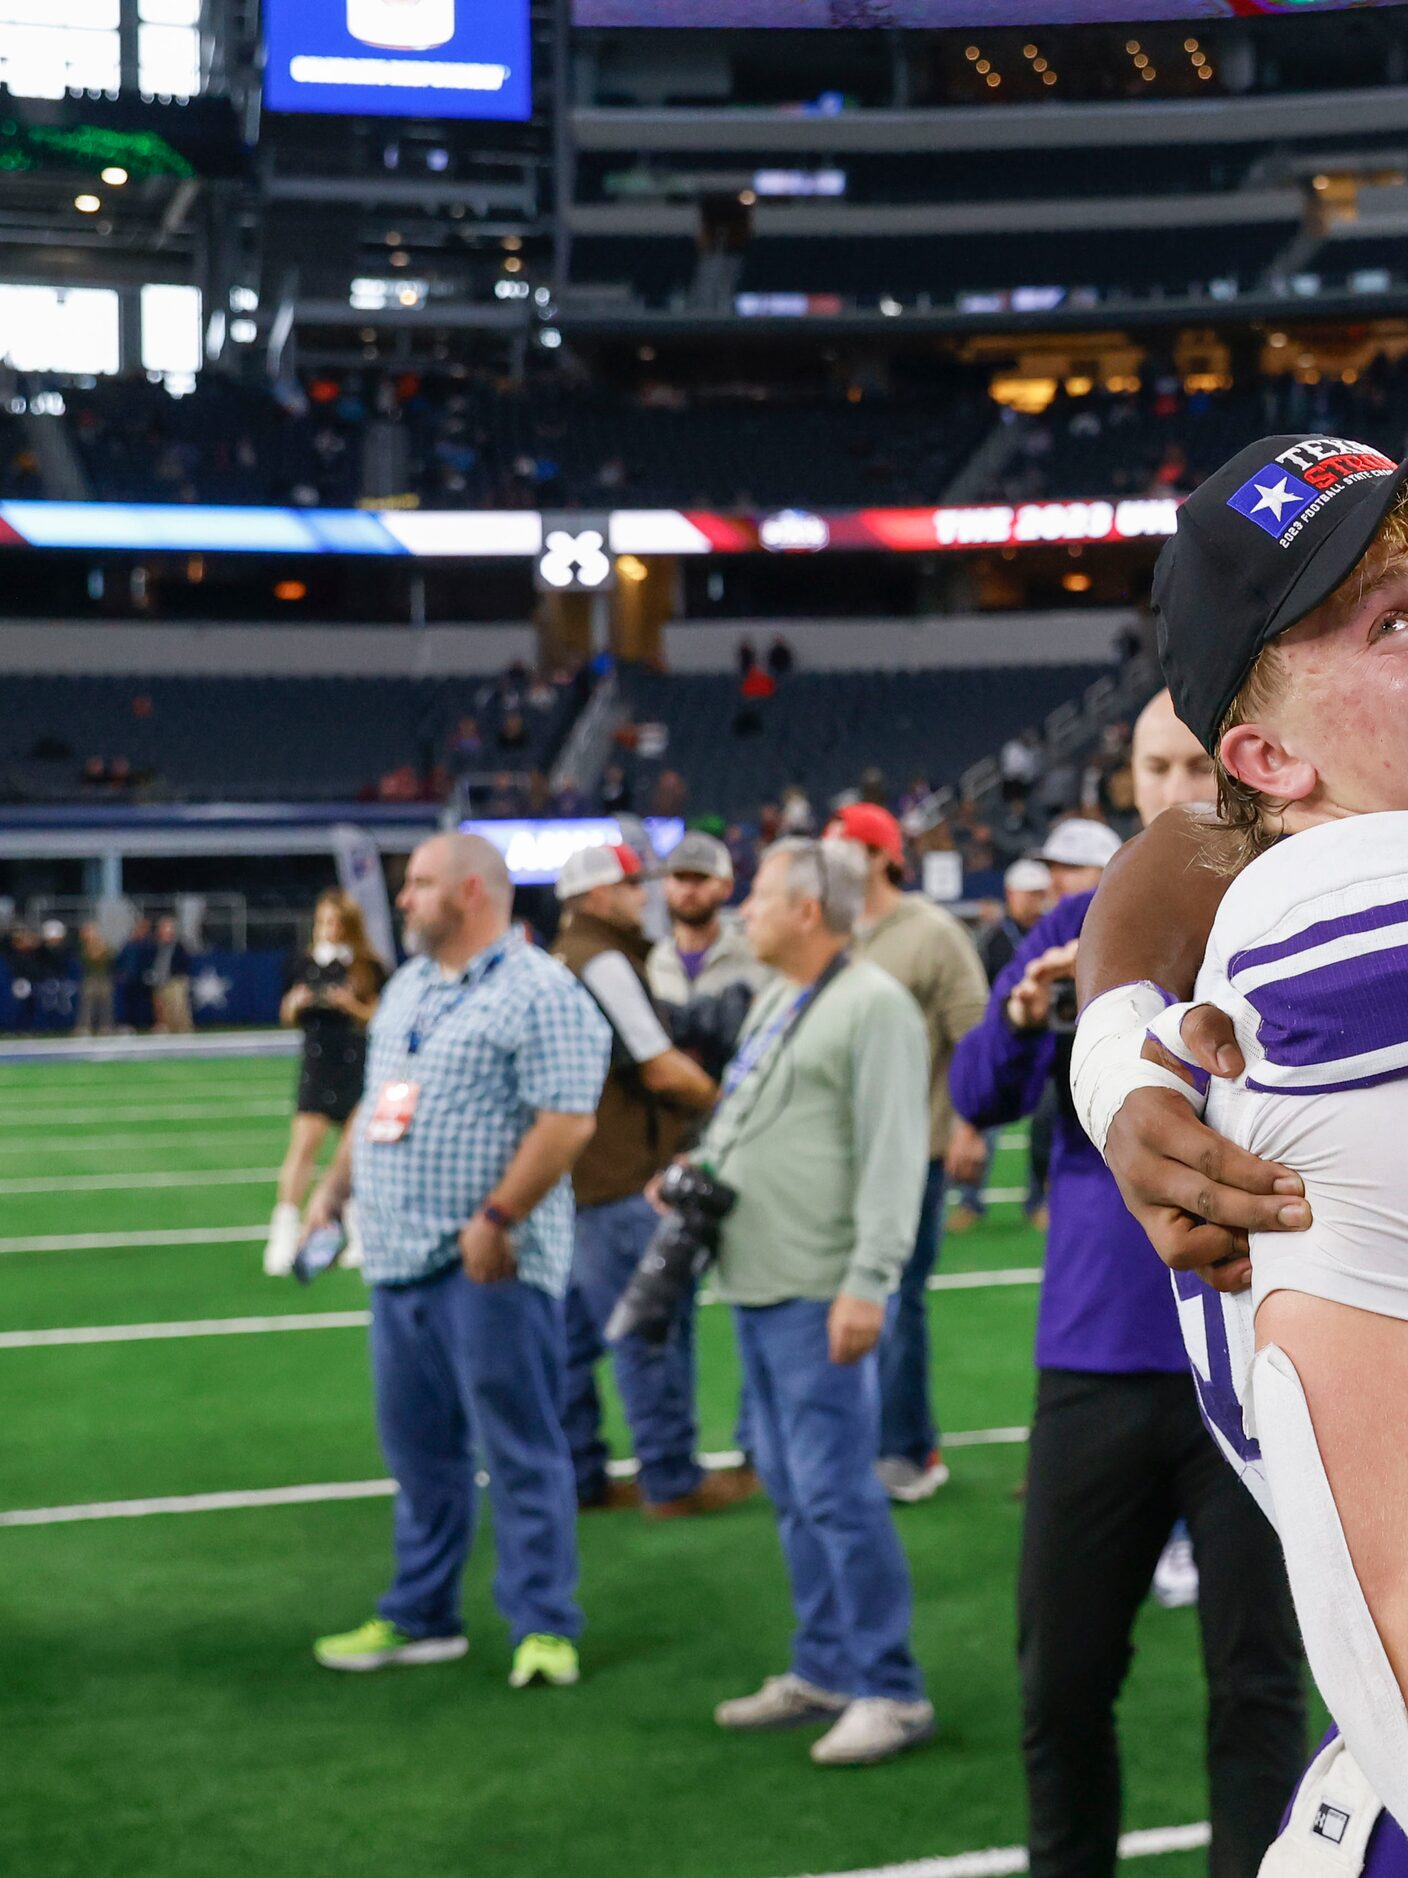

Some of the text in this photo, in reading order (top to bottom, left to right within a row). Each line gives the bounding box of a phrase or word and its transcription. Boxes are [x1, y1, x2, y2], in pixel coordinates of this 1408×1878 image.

[1279, 521, 1304, 549] 2023
[1301, 484, 1345, 524] FOOTBALL
[1343, 471, 1373, 485] STATE
